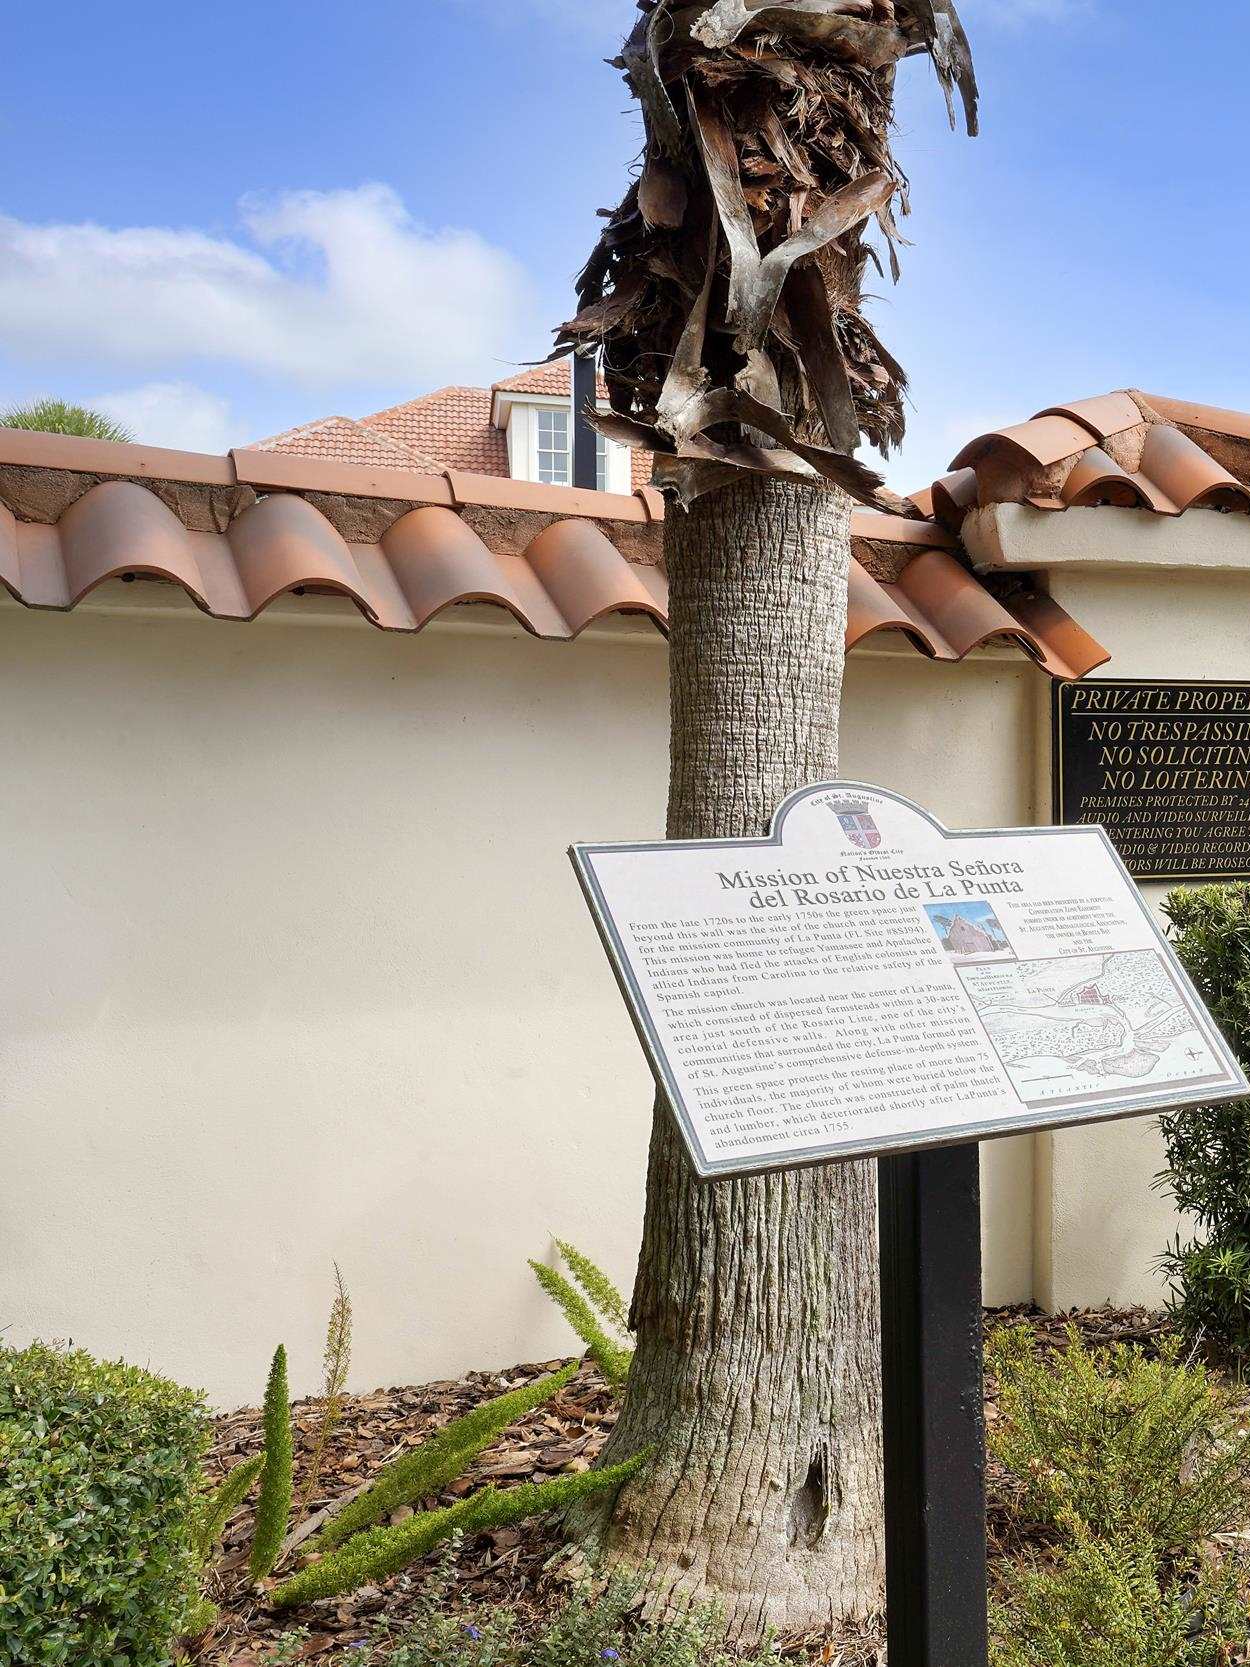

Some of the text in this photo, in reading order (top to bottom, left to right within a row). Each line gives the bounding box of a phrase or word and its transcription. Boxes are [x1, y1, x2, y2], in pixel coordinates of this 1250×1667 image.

[1071, 689, 1172, 710] PRIVATE
[1088, 721, 1122, 741] NO
[1099, 746, 1132, 766] NO
[1101, 771, 1135, 790] NO
[1080, 796, 1143, 808] PREMISES
[1146, 795, 1219, 807] PROTECTED
[1220, 795, 1239, 806] BY
[1076, 812, 1120, 824] AUDIO
[1122, 811, 1152, 824] AND
[1154, 811, 1193, 823] VIDEO
[1108, 827, 1174, 840] ENTERING
[1176, 826, 1203, 839] YOU
[1203, 826, 1246, 838] AGREE
[1161, 842, 1201, 854] VIDEO
[714, 859, 1024, 890] Mission of Nuestra Señora
[1154, 858, 1189, 870] WILL
[1191, 857, 1207, 869] BE
[749, 879, 1024, 909] del Rosario de La Punta
[628, 922, 658, 931] From
[660, 920, 677, 929] the
[679, 919, 700, 927] late
[703, 917, 734, 926] 1720s
[748, 914, 764, 923] the
[767, 913, 791, 922] early
[794, 911, 824, 920] 1750s
[825, 909, 840, 917] the
[843, 909, 870, 918] green
[871, 907, 897, 916] space
[899, 905, 916, 914] just
[632, 931, 674, 944] beyond
[676, 931, 698, 939] this
[700, 928, 724, 937] wall
[749, 926, 766, 934] the
[803, 922, 819, 930] the
[822, 919, 856, 929] church
[859, 918, 876, 926] and
[878, 916, 920, 925] cemetery
[638, 945, 654, 954] for
[657, 944, 675, 953] the
[678, 942, 721, 951] mission
[723, 937, 780, 948] community
[796, 934, 811, 942] La
[812, 933, 842, 941] Punta
[863, 929, 883, 937] Site
[646, 968, 689, 977] Indians
[691, 965, 715, 974] who
[716, 962, 737, 972] had
[739, 960, 761, 970] fled
[763, 960, 780, 968] the
[783, 956, 819, 967] attacks
[834, 951, 873, 963] English
[874, 949, 918, 959] colonists
[920, 946, 937, 955] and
[656, 990, 701, 1003] Spanish
[664, 1008, 684, 1017] The
[686, 1005, 728, 1015] mission
[730, 1000, 766, 1011] church
[788, 993, 826, 1005] located
[850, 991, 866, 999] the
[868, 989, 897, 997] center
[911, 985, 925, 993] La
[667, 1018, 702, 1029] which
[705, 1013, 756, 1026] consisted
[773, 1006, 823, 1020] dispersed
[825, 1001, 880, 1013] farmsteads
[882, 998, 914, 1008] within
[677, 1040, 728, 1055] colonial
[731, 1036, 788, 1048] defensive
[835, 1028, 867, 1037] Along
[871, 1023, 896, 1033] with
[899, 1021, 926, 1030] other
[929, 1017, 970, 1026] mission
[722, 1061, 784, 1076] Augustine's
[786, 1053, 861, 1068] comprehensive
[864, 1042, 945, 1059] defense-in-depth
[695, 1086, 719, 1096] This
[722, 1083, 753, 1095] green
[755, 1079, 784, 1090] space
[787, 1073, 830, 1087] protects
[831, 1070, 848, 1079] the
[850, 1067, 884, 1077] resting
[886, 1063, 913, 1074] place
[928, 1058, 952, 1067] more
[954, 1055, 976, 1063] than
[976, 1052, 990, 1061] 75
[768, 1091, 786, 1100] the
[789, 1086, 834, 1098] majority
[852, 1079, 884, 1089] whom
[886, 1076, 910, 1085] were
[912, 1070, 946, 1081] buried
[947, 1067, 976, 1077] below
[979, 1064, 994, 1073] the
[710, 1124, 731, 1136] and
[782, 1113, 817, 1125] which
[820, 1103, 886, 1120] deteriorated
[889, 1098, 925, 1110] shortly
[930, 1096, 953, 1105] after
[715, 1131, 789, 1149] abandonment
[792, 1128, 820, 1137] circa
